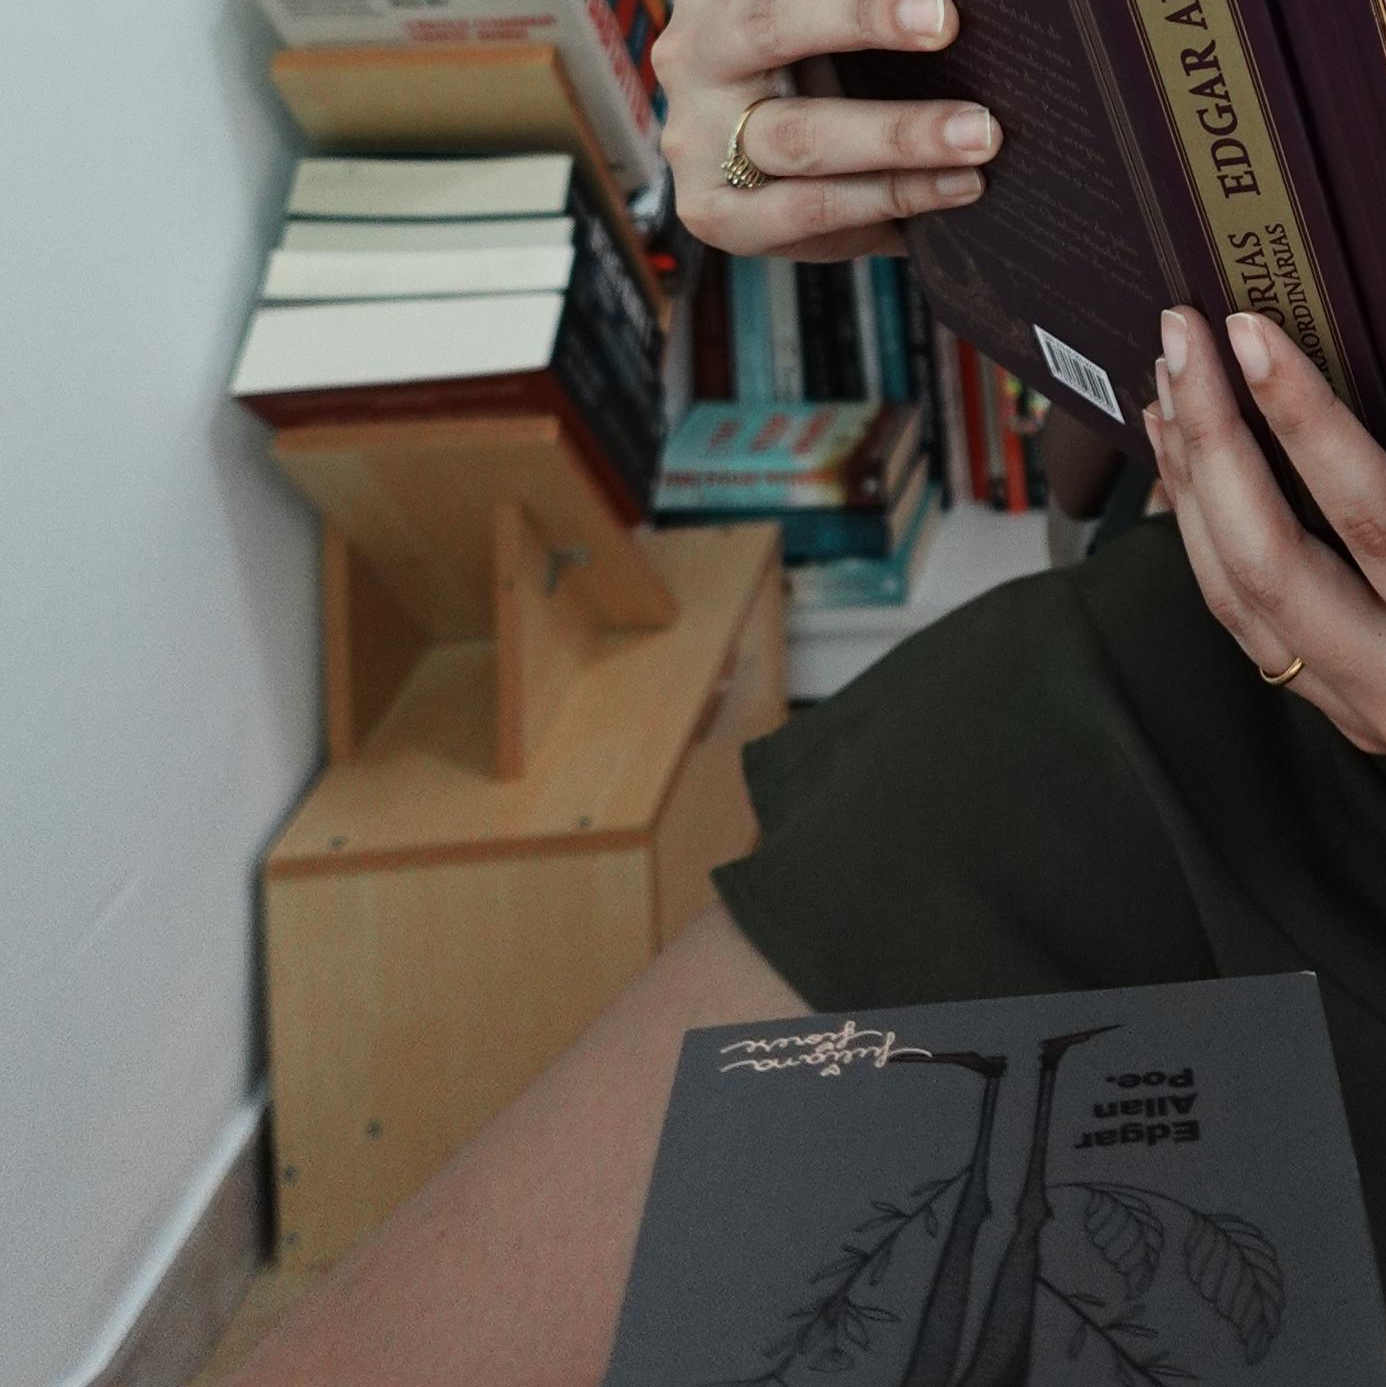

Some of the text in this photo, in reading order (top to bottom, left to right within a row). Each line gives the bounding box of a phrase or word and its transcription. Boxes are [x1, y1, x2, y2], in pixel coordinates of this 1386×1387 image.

[1179, 38, 1261, 199] EDGAR
[1103, 1065, 1195, 1093] Poe.
[1092, 1091, 1198, 1124] Allan
[1073, 1116, 1202, 1154] Edgar
